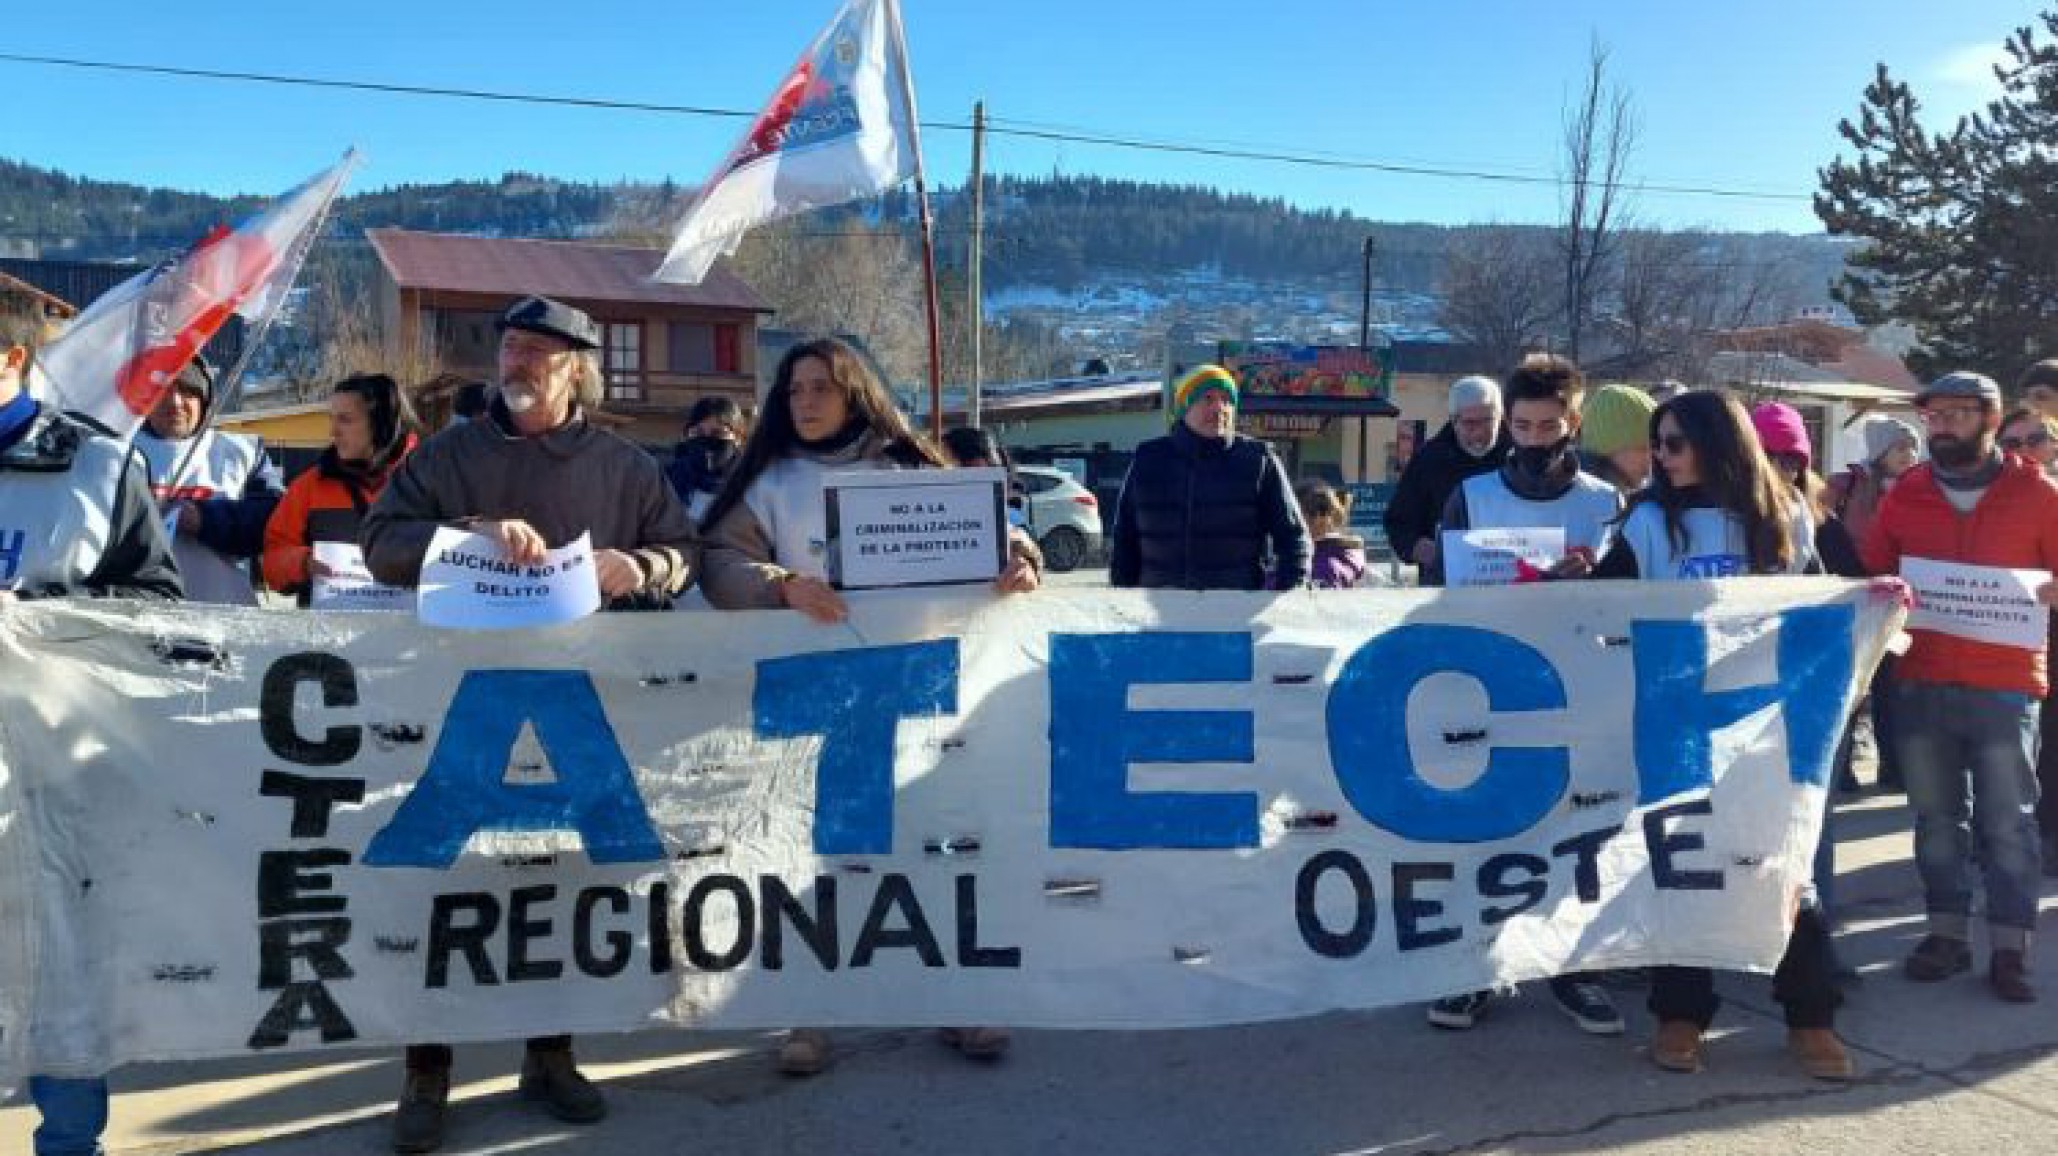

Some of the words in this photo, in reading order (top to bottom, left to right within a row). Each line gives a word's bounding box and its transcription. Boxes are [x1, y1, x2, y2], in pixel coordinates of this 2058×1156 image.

[889, 504, 910, 514] NO
[914, 503, 924, 513] A
[928, 502, 947, 514] LA
[860, 543, 879, 555] DE
[883, 542, 901, 553] LA
[905, 538, 979, 552] PROTESTA
[439, 548, 520, 577] LUCHAR
[526, 564, 555, 578] NO
[474, 580, 550, 598] DELITO
[1945, 576, 1965, 586] NO
[1969, 578, 1979, 588] A
[361, 602, 1857, 870] ATECH
[247, 651, 367, 1050] CTERA
[1295, 799, 1724, 959] OESTE
[425, 873, 1021, 989] REGIONAL
